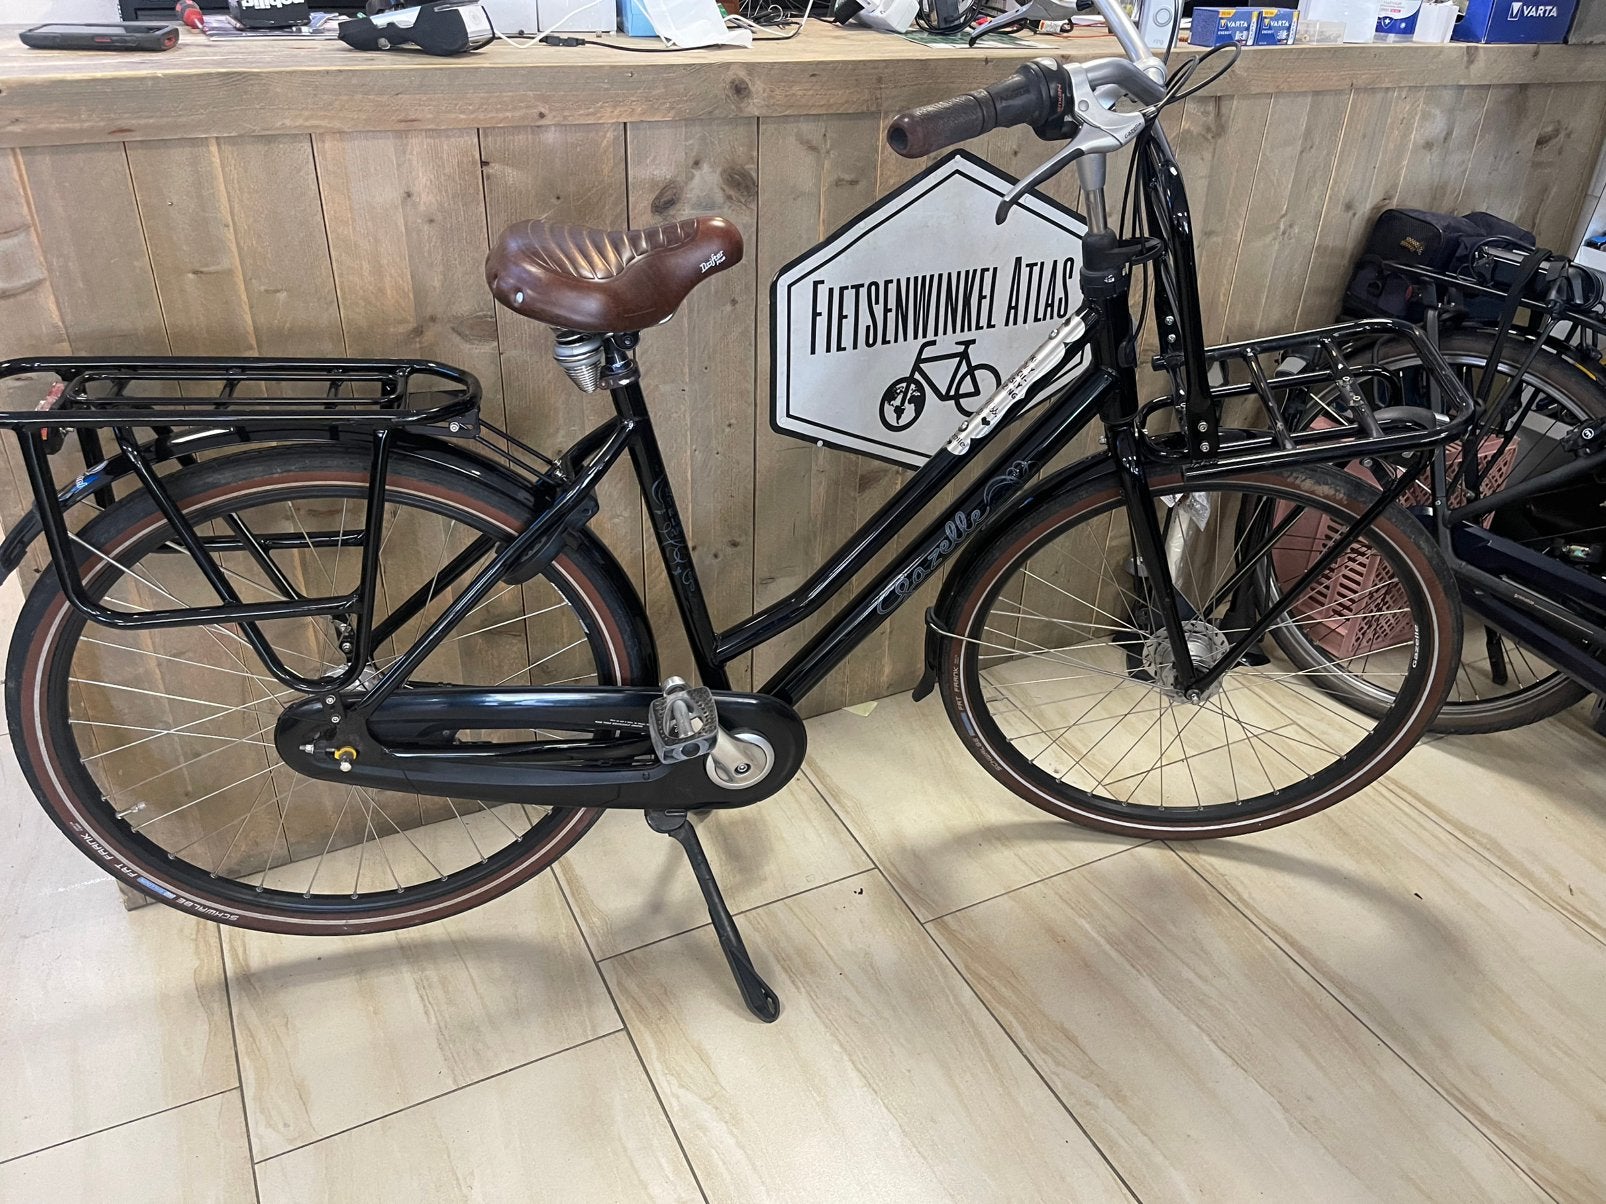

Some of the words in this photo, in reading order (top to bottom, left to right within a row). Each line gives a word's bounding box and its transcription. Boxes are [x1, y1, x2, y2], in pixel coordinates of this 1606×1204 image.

[1523, 5, 1558, 17] VARTA
[1227, 20, 1248, 28] VARTA
[810, 267, 998, 355] FIETSENWINKEL
[1004, 256, 1075, 328] ATLAS
[876, 510, 989, 615] Gazelle
[80, 833, 114, 861] FRANK
[114, 863, 139, 879] FAT
[177, 897, 240, 922] SCHWALBE
